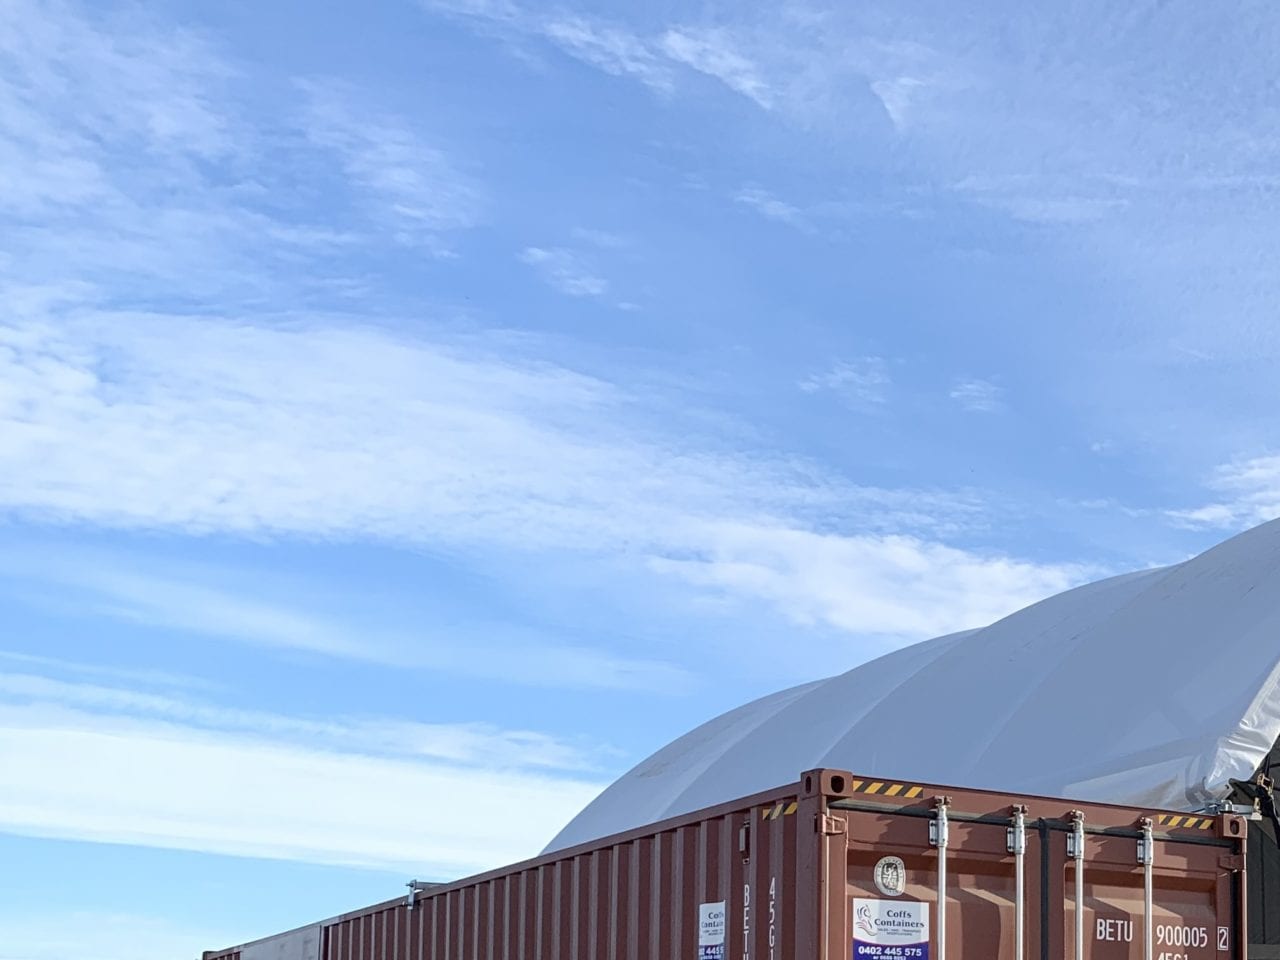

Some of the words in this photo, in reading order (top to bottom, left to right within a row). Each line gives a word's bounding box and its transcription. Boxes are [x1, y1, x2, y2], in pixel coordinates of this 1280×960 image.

[886, 909, 912, 918] Coffs
[874, 918, 925, 928] Containers
[1096, 918, 1133, 942] BETU
[1156, 925, 1208, 948] 900005
[1219, 928, 1228, 949] 2
[858, 946, 882, 955] 0402
[884, 947, 902, 956] 445
[904, 948, 922, 956] 575
